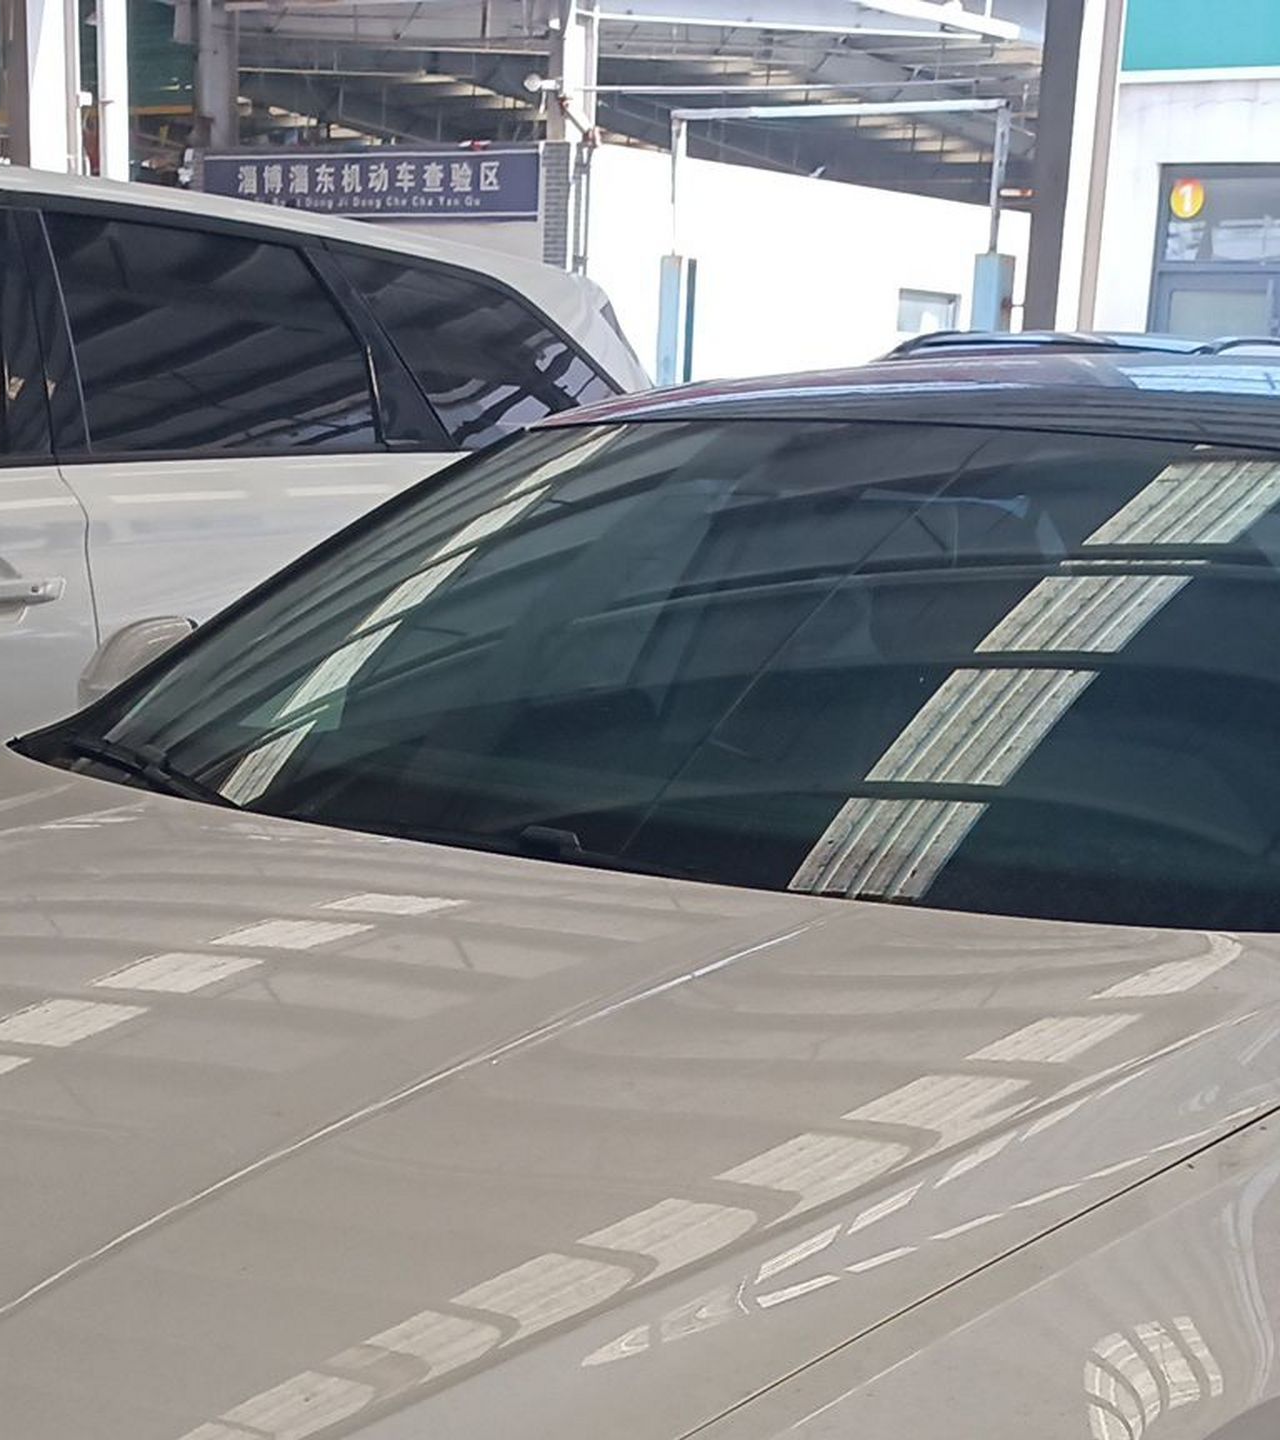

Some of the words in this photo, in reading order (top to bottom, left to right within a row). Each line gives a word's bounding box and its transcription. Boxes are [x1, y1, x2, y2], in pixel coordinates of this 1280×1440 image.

[237, 160, 501, 194] 淄博淄东机动车查验区
[1177, 183, 1194, 212] 1
